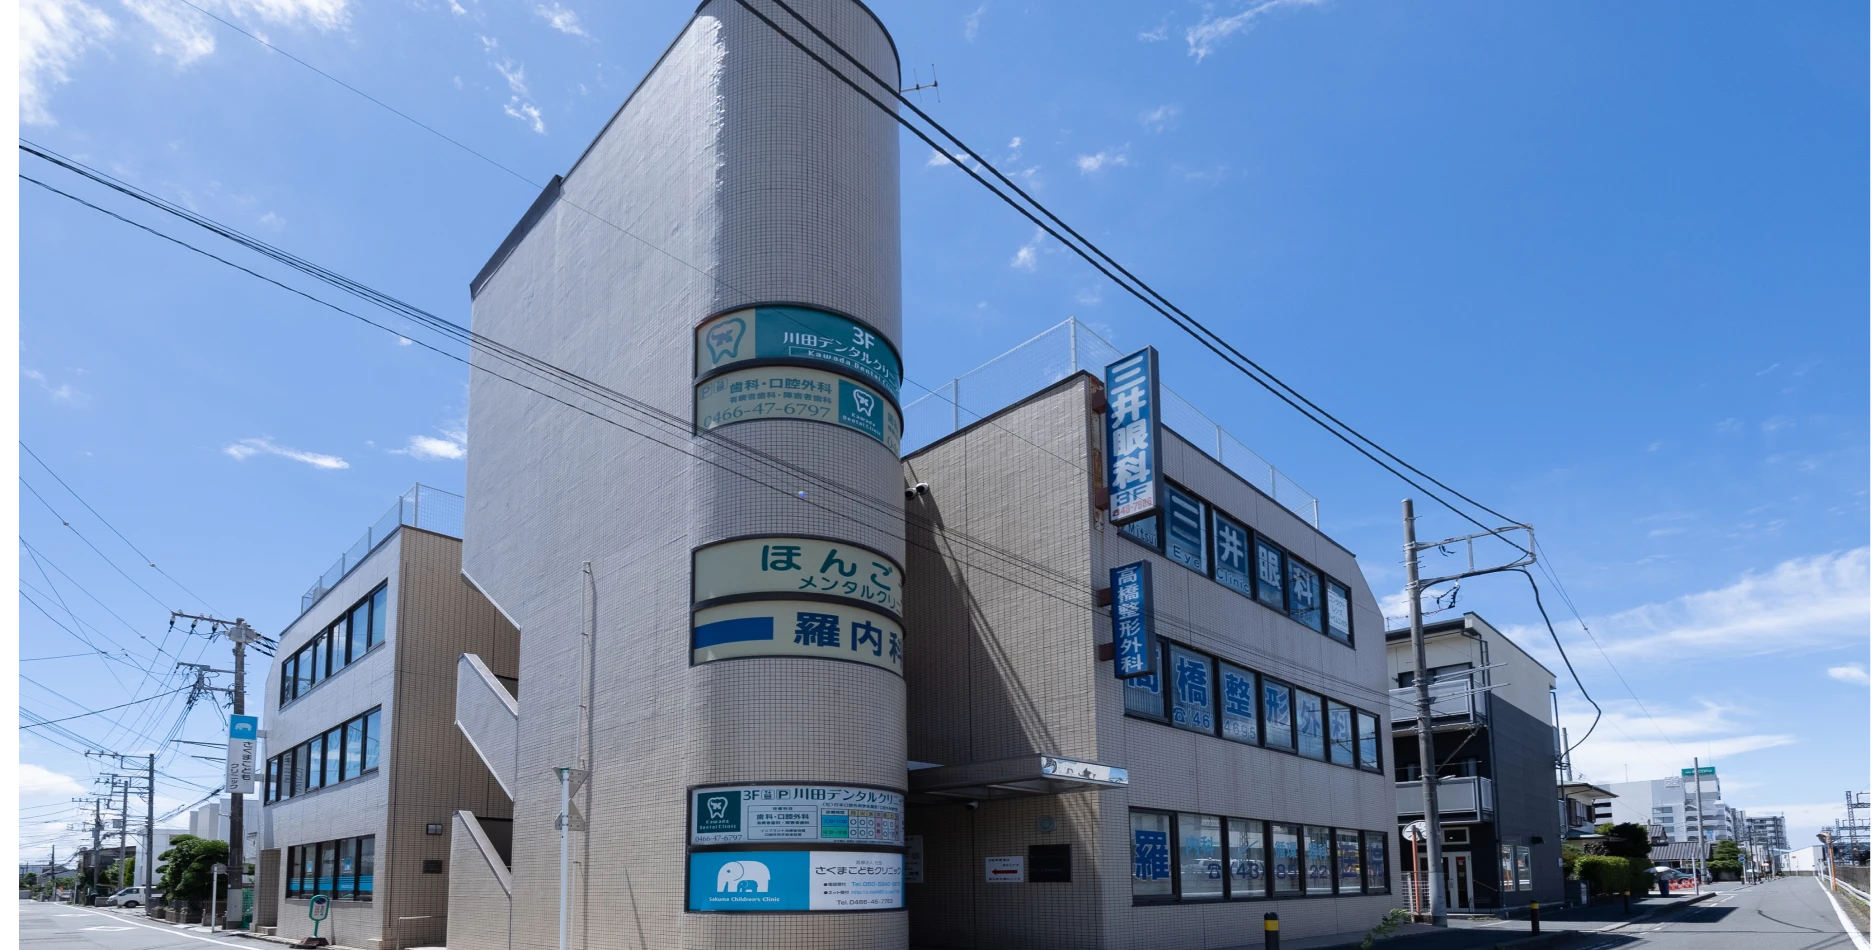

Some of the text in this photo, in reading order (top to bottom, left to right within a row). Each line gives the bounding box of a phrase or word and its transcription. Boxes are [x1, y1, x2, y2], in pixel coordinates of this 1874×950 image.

[852, 326, 875, 349] 3F
[783, 331, 899, 392] 川田デンタルクリニ
[808, 350, 851, 366] Kawada
[854, 362, 881, 382] Dental
[730, 378, 832, 395] 歯科・口腔外科
[703, 403, 831, 428] 0466-47-6797
[1111, 355, 1150, 490] 三井眼科
[1116, 484, 1148, 506] 3F
[762, 545, 901, 592] ほんご
[1171, 495, 1313, 606] 三井眼科
[1173, 545, 1201, 569] Eye
[1216, 566, 1250, 593] Clinic
[1117, 566, 1144, 673] 高橋整形外科
[230, 763, 239, 790] クリニック
[241, 741, 253, 781] さくまこども
[743, 790, 760, 800] 3F
[815, 866, 901, 875] さくまこどもクリニック
[1134, 830, 1169, 881] 羅
